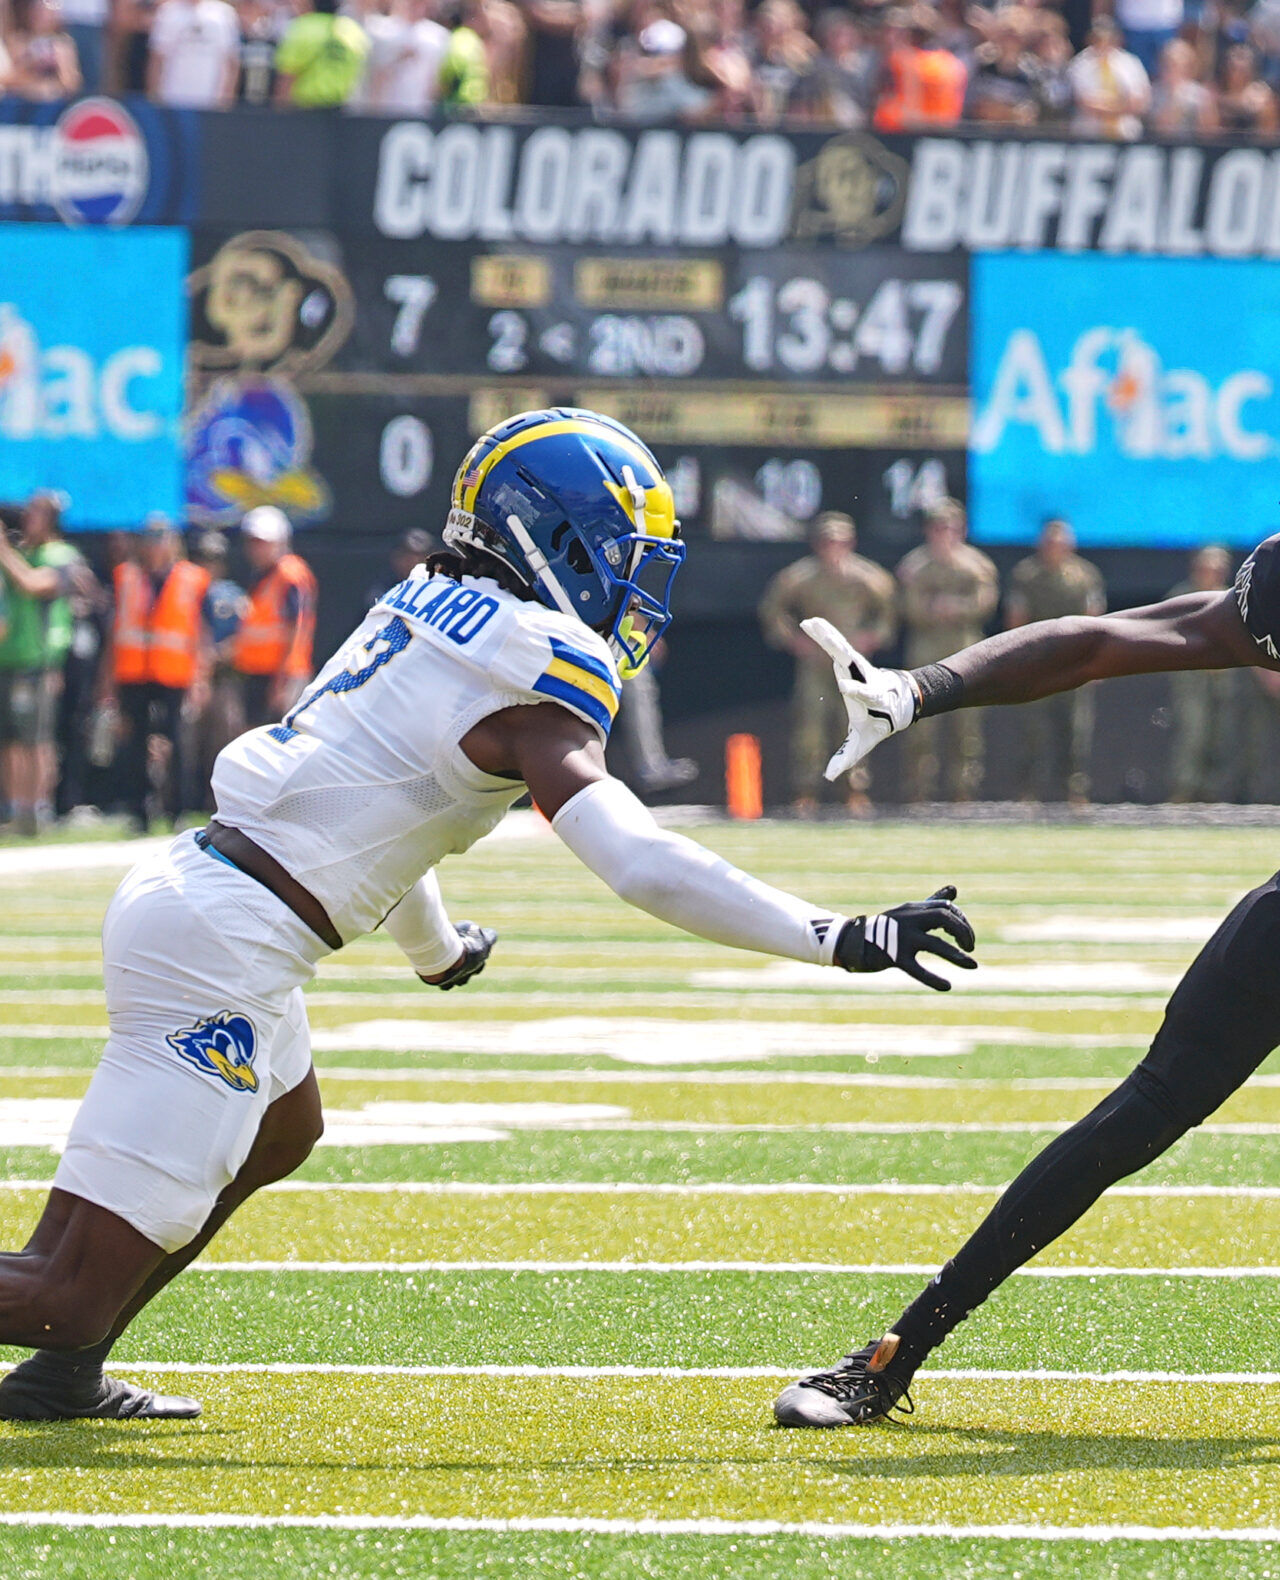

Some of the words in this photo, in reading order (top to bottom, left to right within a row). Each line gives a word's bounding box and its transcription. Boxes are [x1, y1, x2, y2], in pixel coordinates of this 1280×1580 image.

[374, 121, 796, 248] COLORADO
[384, 274, 437, 356] 7
[588, 314, 705, 376] 2ND
[729, 275, 963, 374] 13:47
[968, 325, 1273, 461] Aflac
[379, 415, 432, 496] 0
